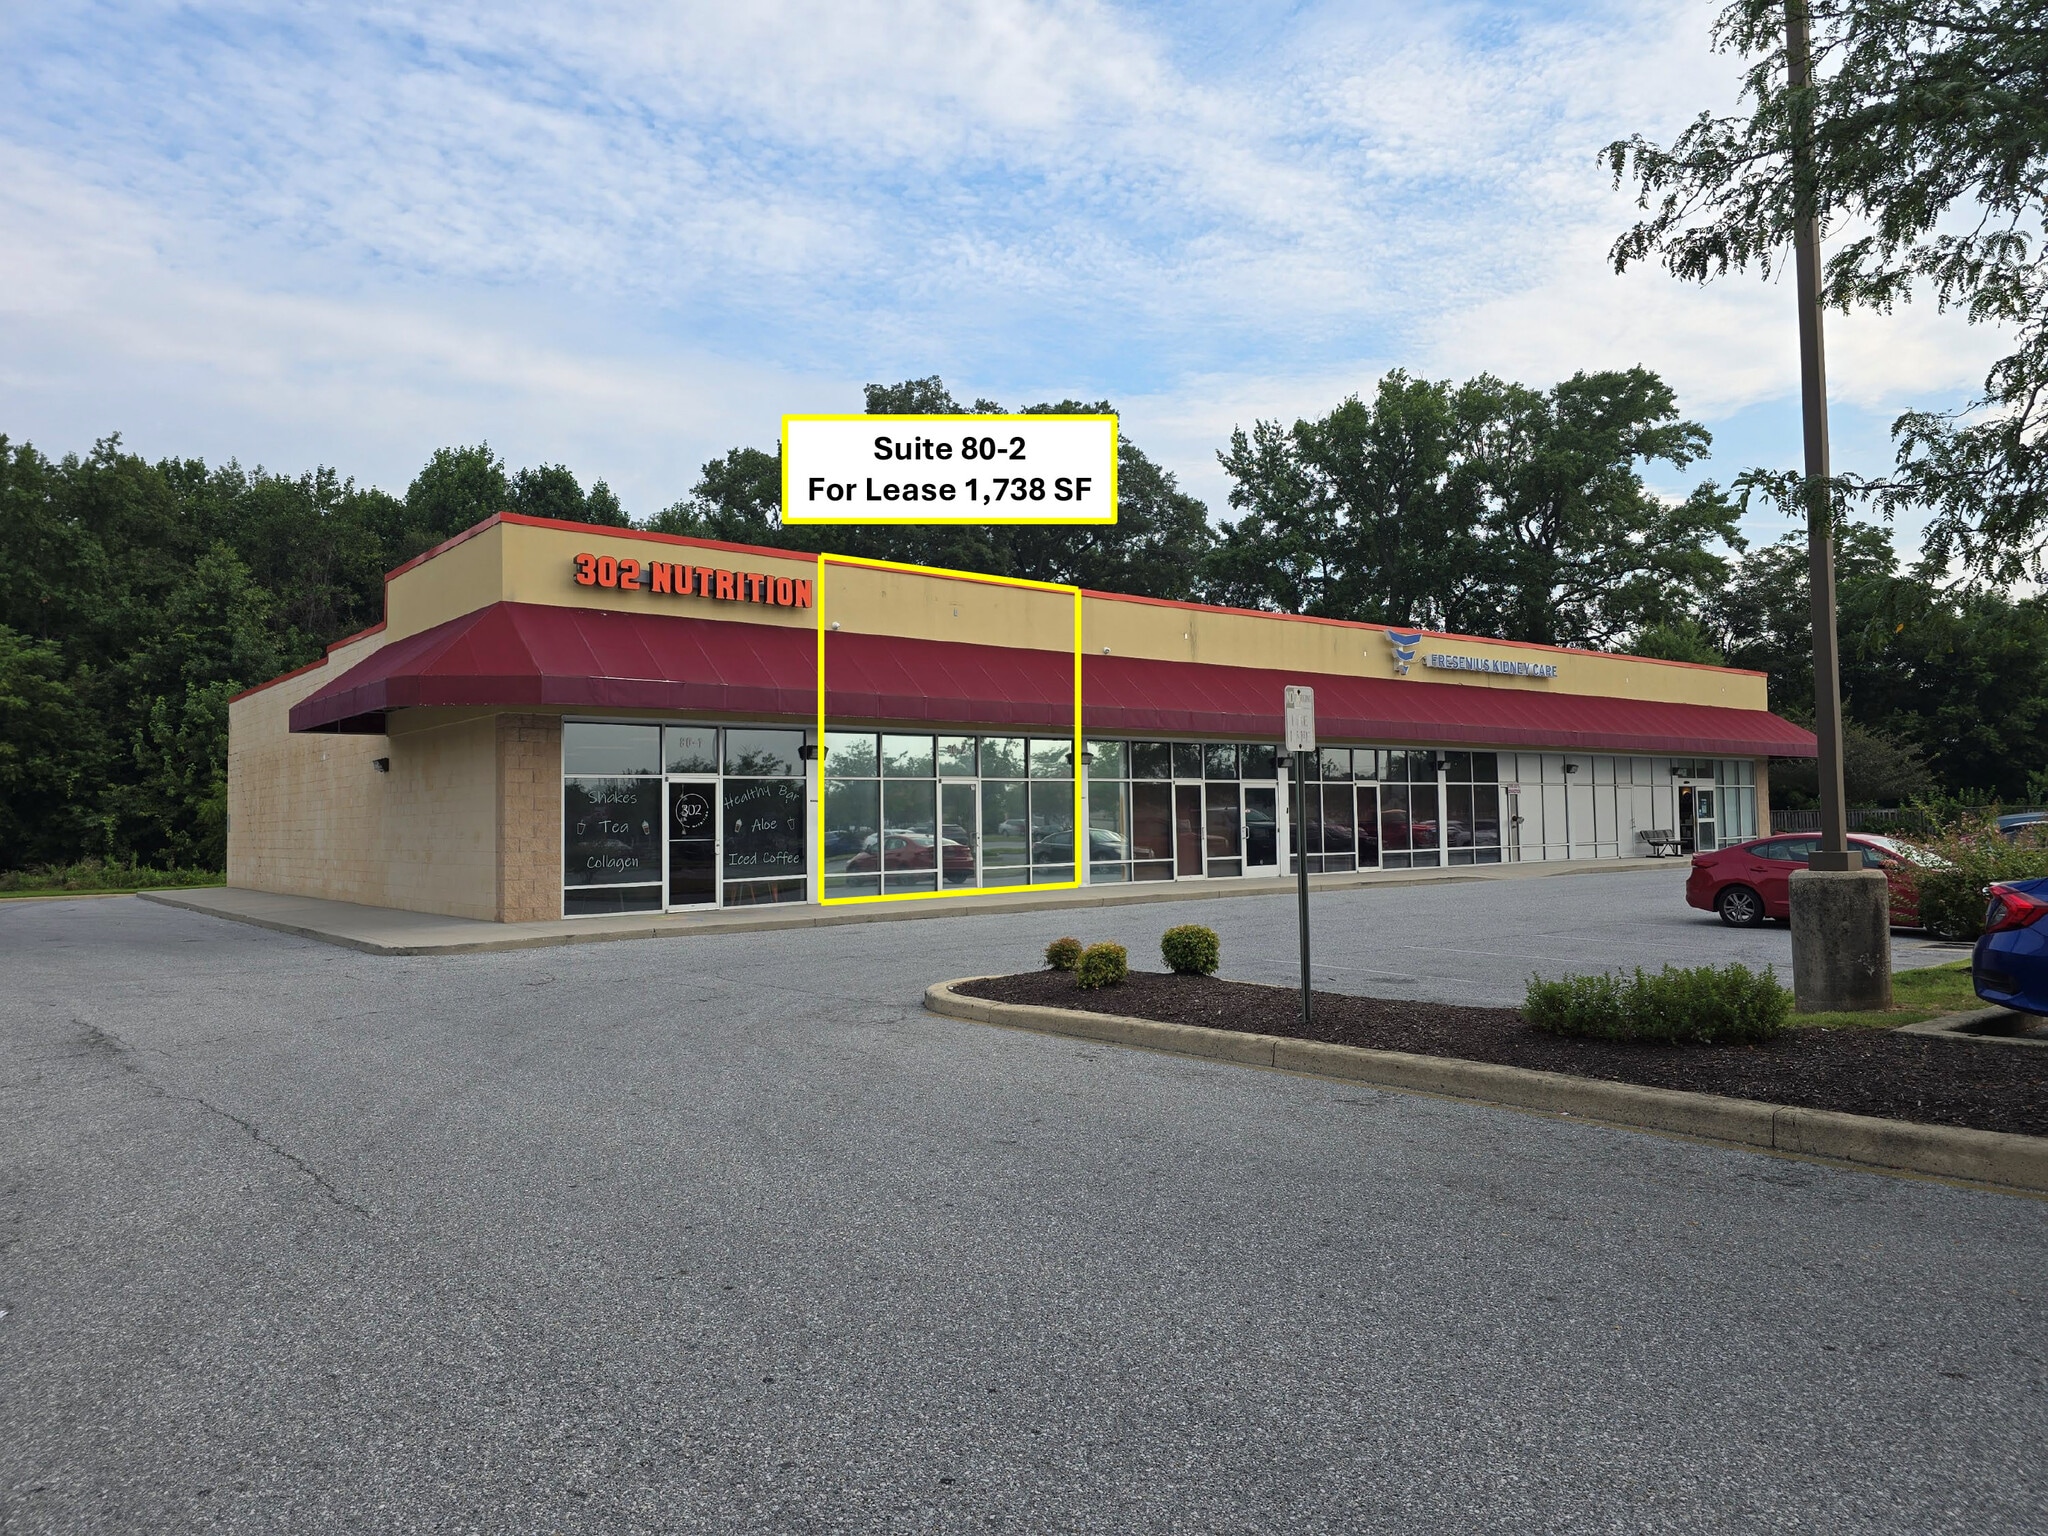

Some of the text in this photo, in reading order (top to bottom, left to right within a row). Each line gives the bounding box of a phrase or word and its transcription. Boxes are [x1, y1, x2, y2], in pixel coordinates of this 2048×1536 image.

[574, 552, 813, 609] 302 NUTRITION
[1431, 654, 1558, 678] FRESENIUS KIDNEY CARE
[588, 790, 638, 804] Shakes
[723, 784, 799, 810] Healthy Bar
[681, 804, 702, 817] 302
[598, 820, 629, 833] Tea
[751, 818, 778, 833] Aloe
[586, 855, 639, 873] Collagen
[728, 851, 800, 866] Iced Coffee
